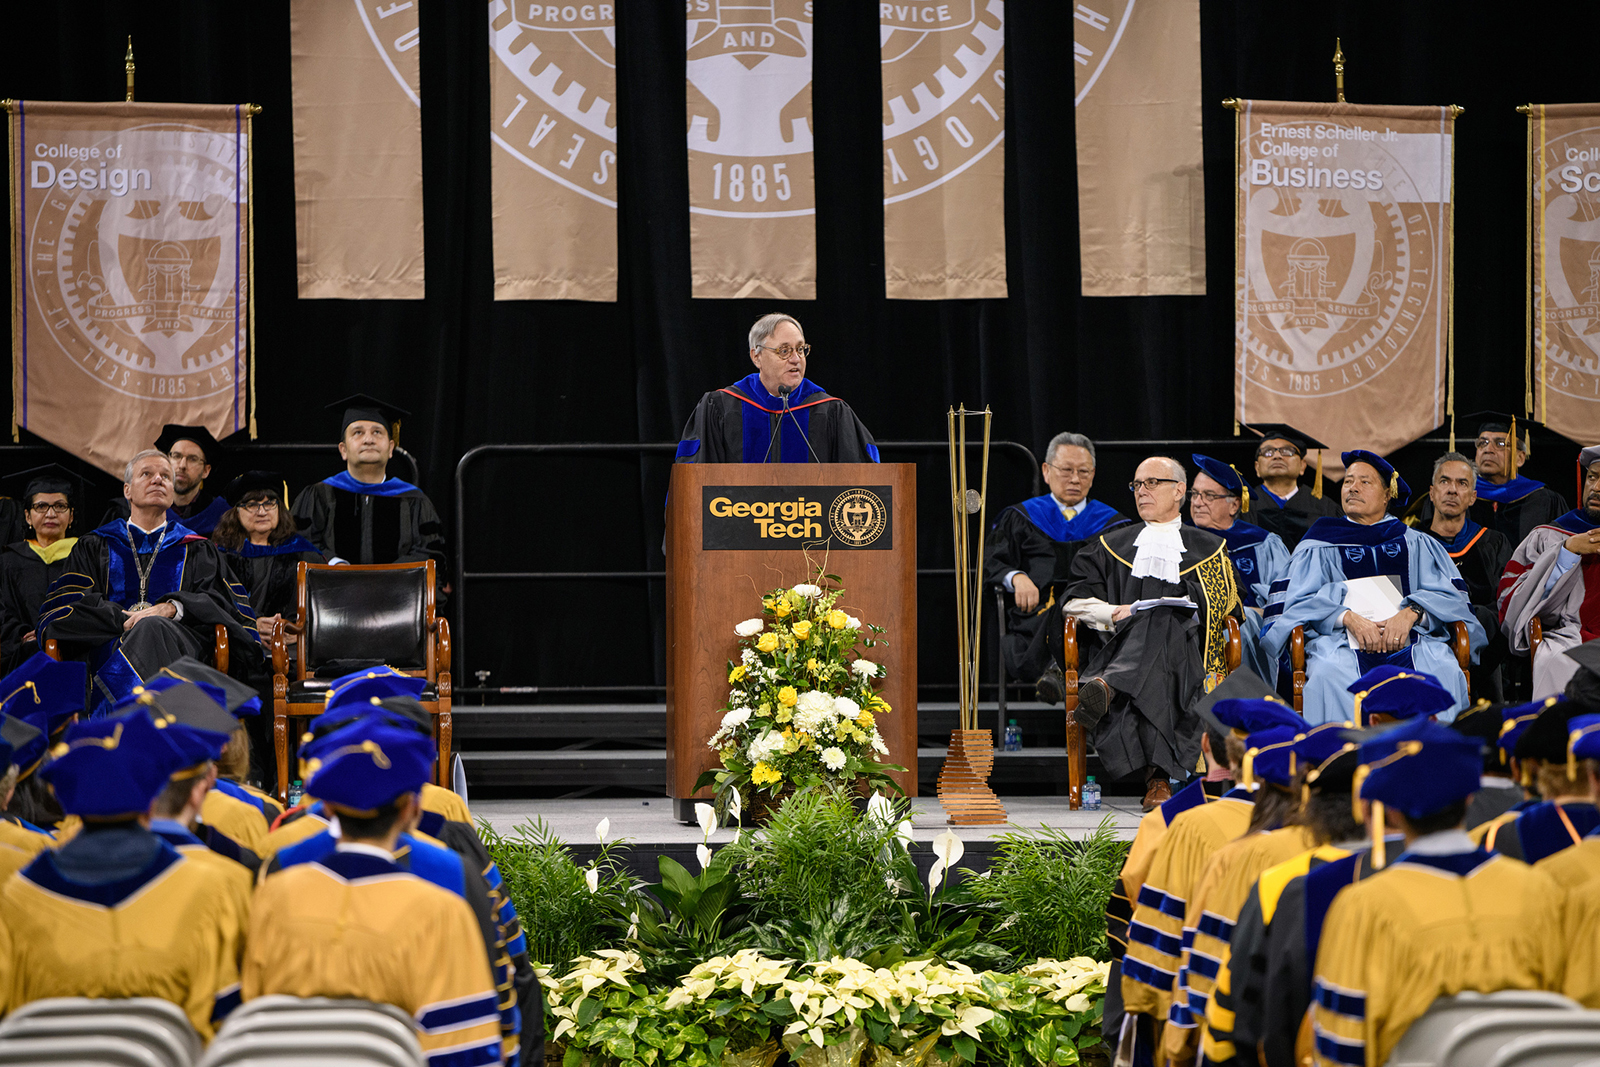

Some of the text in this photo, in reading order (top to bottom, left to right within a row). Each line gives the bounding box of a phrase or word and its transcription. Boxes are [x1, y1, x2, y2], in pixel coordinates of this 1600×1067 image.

[723, 31, 775, 49] AND
[502, 93, 616, 185] SEAL
[1261, 122, 1399, 142] Ernest Scheller Jr.
[34, 143, 122, 161] College of
[1260, 140, 1319, 160] College
[1322, 143, 1339, 158] of
[1566, 147, 1600, 162] Coll
[31, 160, 152, 197] Design
[712, 162, 792, 203] 1885
[1251, 159, 1384, 191] Business
[36, 237, 55, 276] THE
[94, 305, 152, 317] PROGRESS
[1328, 304, 1370, 316] SERVICE
[156, 320, 181, 329] AND
[1295, 317, 1317, 326] AND
[1341, 267, 1429, 385] TECHNOLOGY
[83, 346, 131, 387] SEAL
[151, 377, 187, 395] 1885
[1289, 373, 1321, 392] 1885
[709, 496, 822, 521] Georgia
[753, 518, 822, 538] Tech
